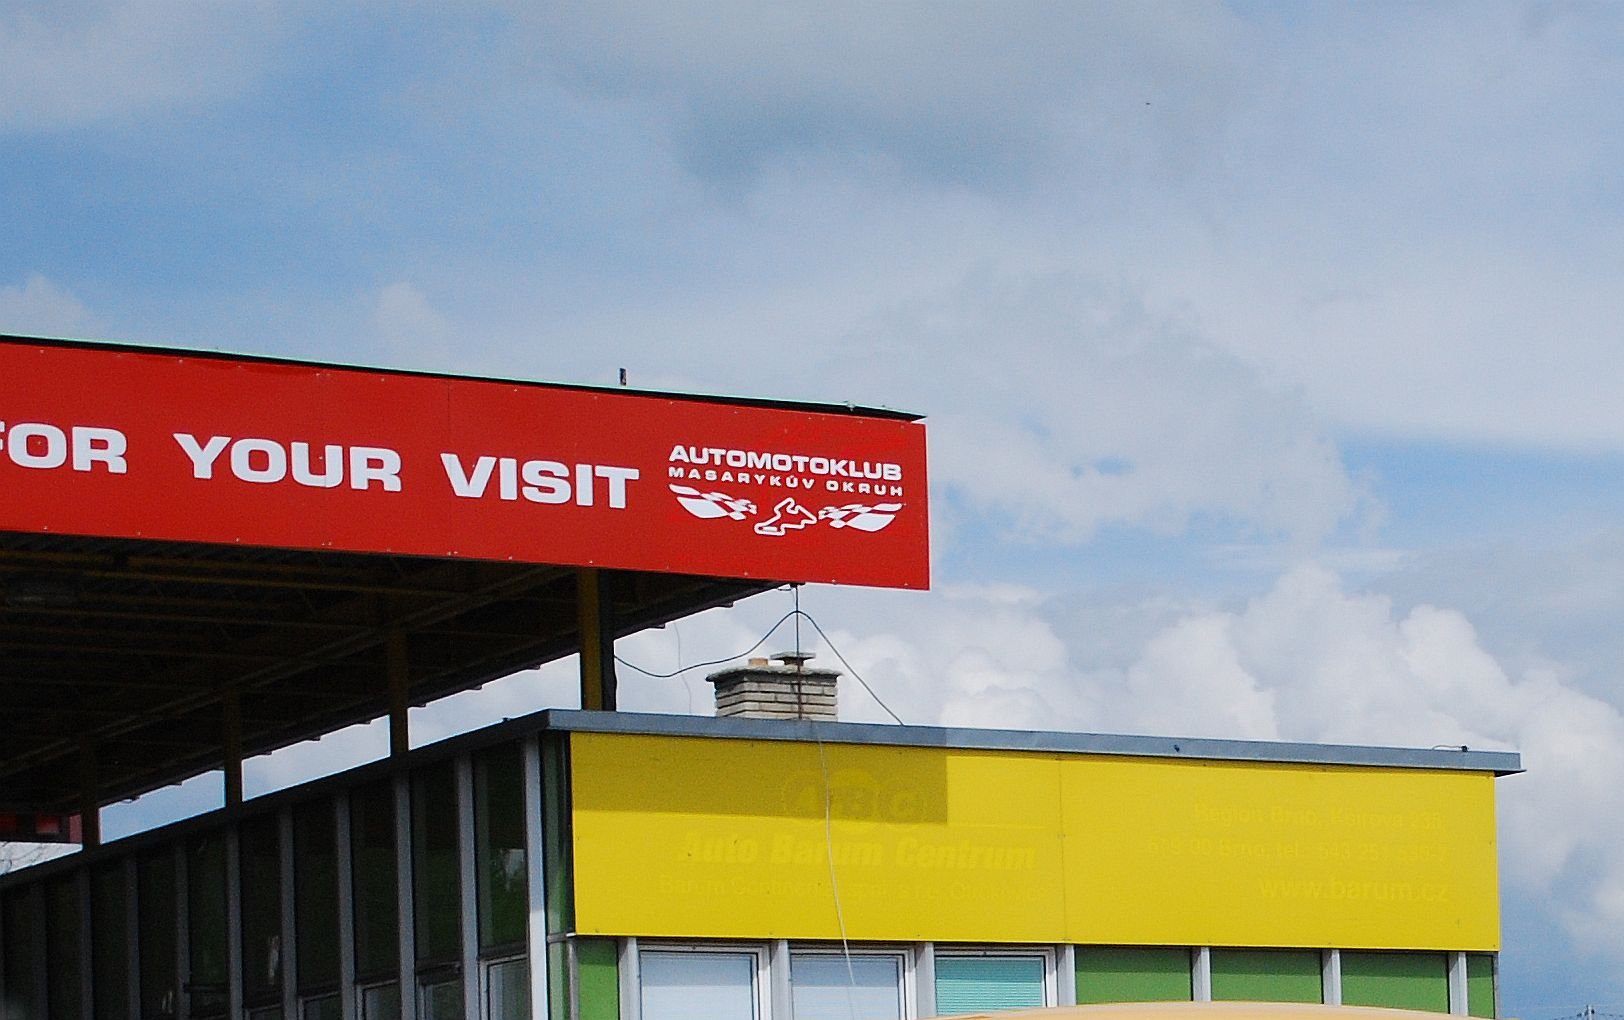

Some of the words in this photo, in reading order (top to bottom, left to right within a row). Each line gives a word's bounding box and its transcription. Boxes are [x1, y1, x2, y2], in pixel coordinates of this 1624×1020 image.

[0, 420, 127, 474] OR
[172, 432, 402, 492] YOUR
[439, 452, 640, 509] VISIT
[668, 444, 902, 481] AUTOMOTOKLUB
[825, 479, 903, 497] OKRUH
[769, 832, 883, 866] Barum
[895, 835, 1038, 871] Centrum
